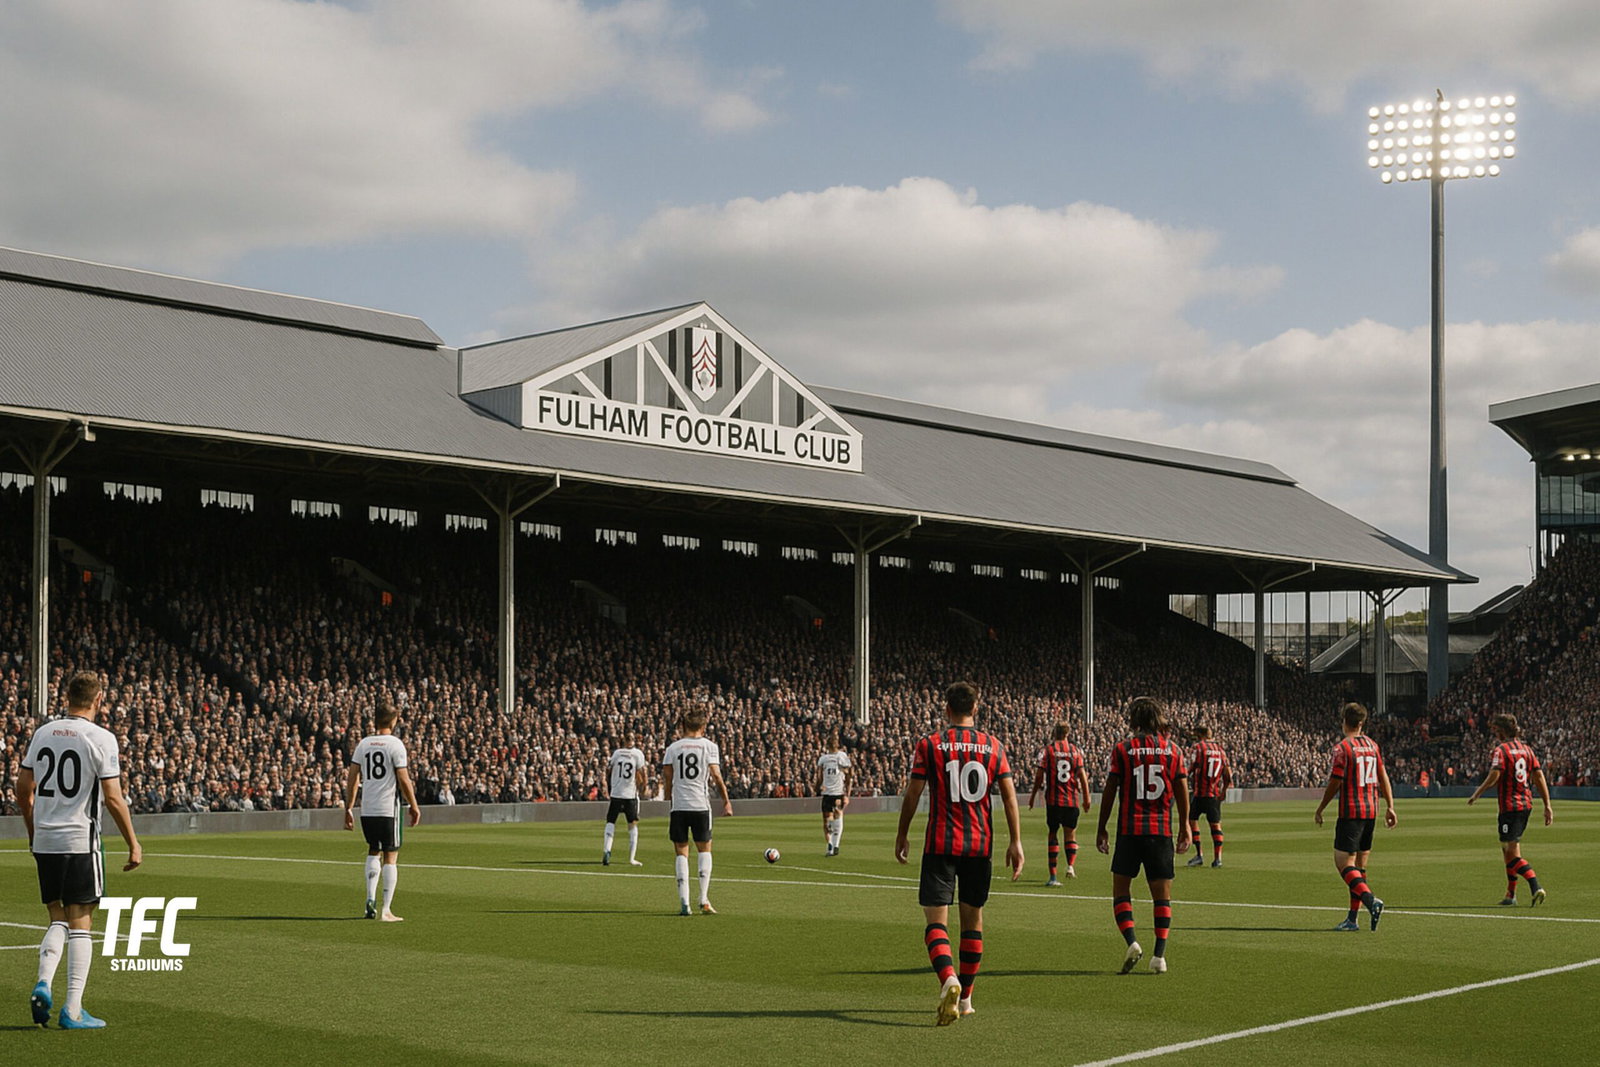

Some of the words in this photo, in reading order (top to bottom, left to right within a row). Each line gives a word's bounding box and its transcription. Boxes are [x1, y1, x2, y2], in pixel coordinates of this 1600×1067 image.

[539, 396, 648, 435] FULHAM
[661, 413, 785, 455] FOOTBALL
[794, 433, 850, 464] CLUB
[37, 747, 81, 798] 20
[365, 751, 386, 780] 18
[618, 762, 632, 779] 13
[678, 753, 699, 780] 18
[946, 759, 988, 803] 10
[1057, 760, 1071, 783] 8
[1133, 764, 1165, 800] 15
